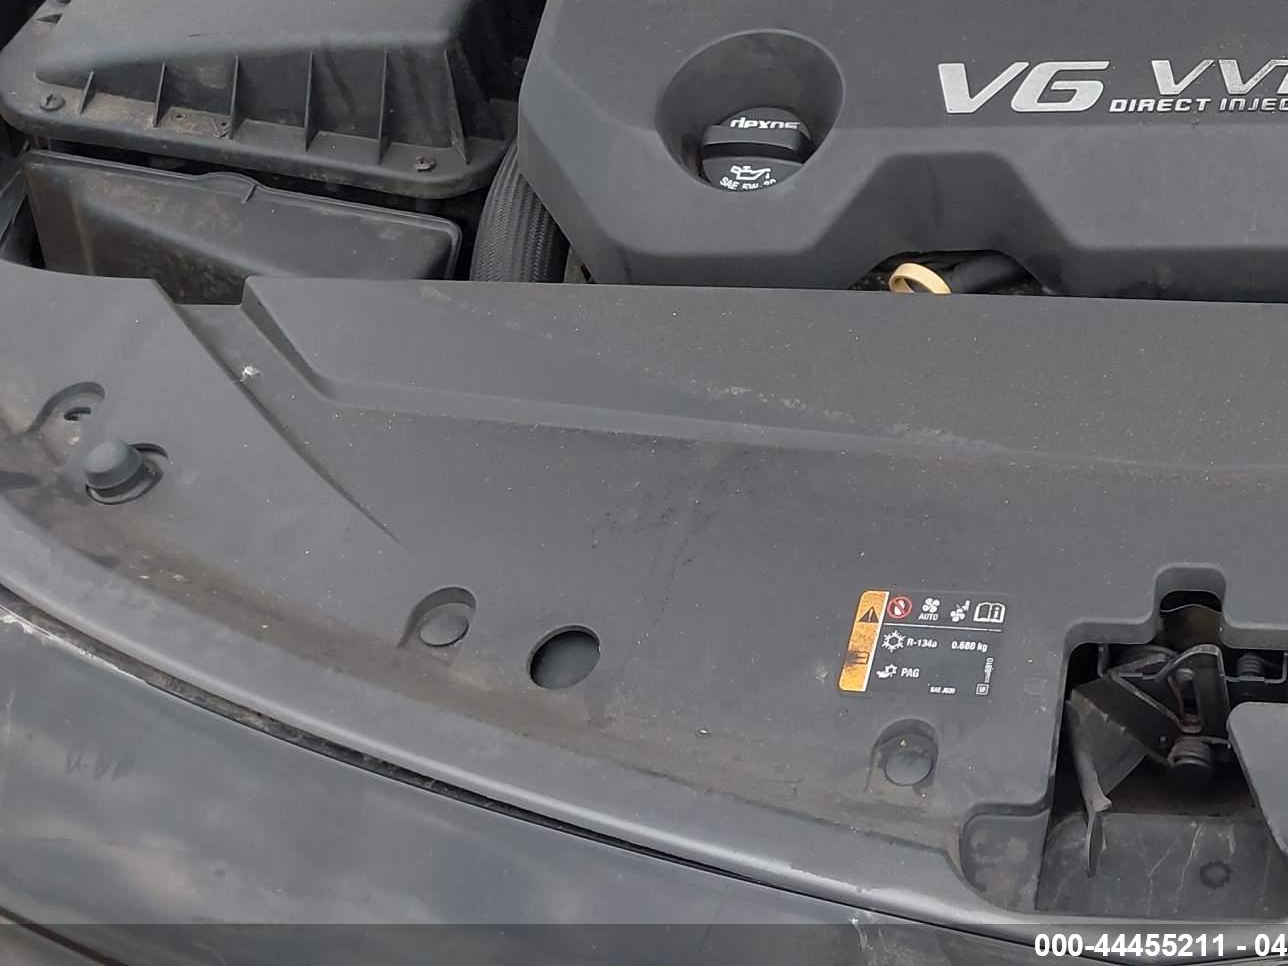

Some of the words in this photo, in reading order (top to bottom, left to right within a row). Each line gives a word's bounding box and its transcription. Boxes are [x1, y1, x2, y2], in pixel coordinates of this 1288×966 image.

[938, 60, 1110, 114] V6
[1109, 98, 1212, 113] DIRECT
[720, 176, 740, 190] SAE
[918, 613, 939, 621] AUTO
[907, 637, 938, 648] R-134a
[977, 641, 989, 653] kg
[901, 667, 920, 678] PAG
